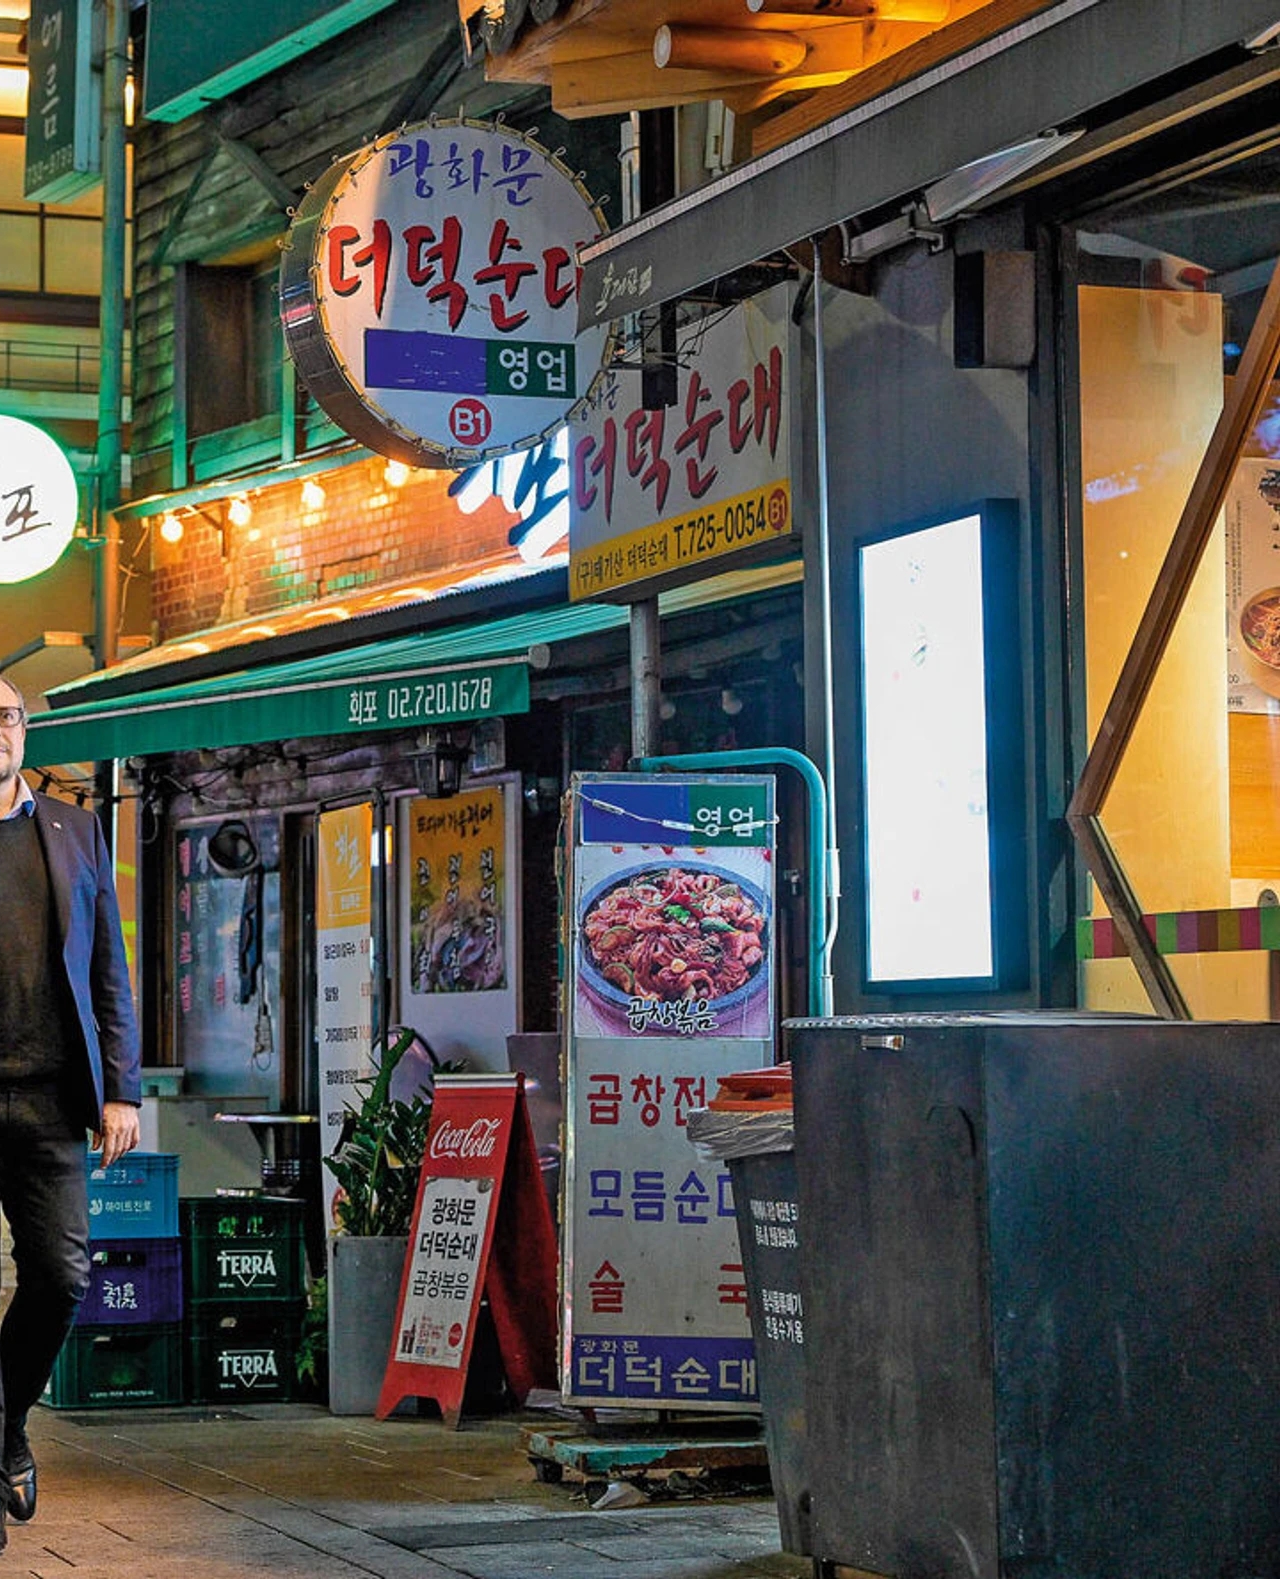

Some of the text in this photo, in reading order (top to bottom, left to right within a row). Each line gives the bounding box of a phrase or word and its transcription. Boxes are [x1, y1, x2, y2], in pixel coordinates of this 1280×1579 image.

[386, 138, 542, 206] 광화문
[499, 347, 568, 393] 영업
[452, 406, 490, 438] B1
[575, 345, 783, 527] 더덕순대
[673, 496, 767, 560] T.725-0054
[348, 677, 493, 724] 회포 02.720.1678
[696, 805, 754, 839] 영업
[626, 995, 720, 1033] 곱창볶음
[587, 1072, 720, 1128] 곱창전
[430, 1117, 503, 1160] Coca-Cola
[104, 1200, 153, 1213] 하이트진로
[432, 1197, 476, 1226] 광화문
[216, 1252, 277, 1277] TERRA
[420, 1230, 479, 1262] 더덕순대
[412, 1269, 470, 1301] 곱창볶음
[588, 1259, 625, 1314] 술
[218, 1351, 279, 1378] TERRA
[580, 1339, 640, 1354] 광화문
[577, 1355, 757, 1396] 더덕순대
